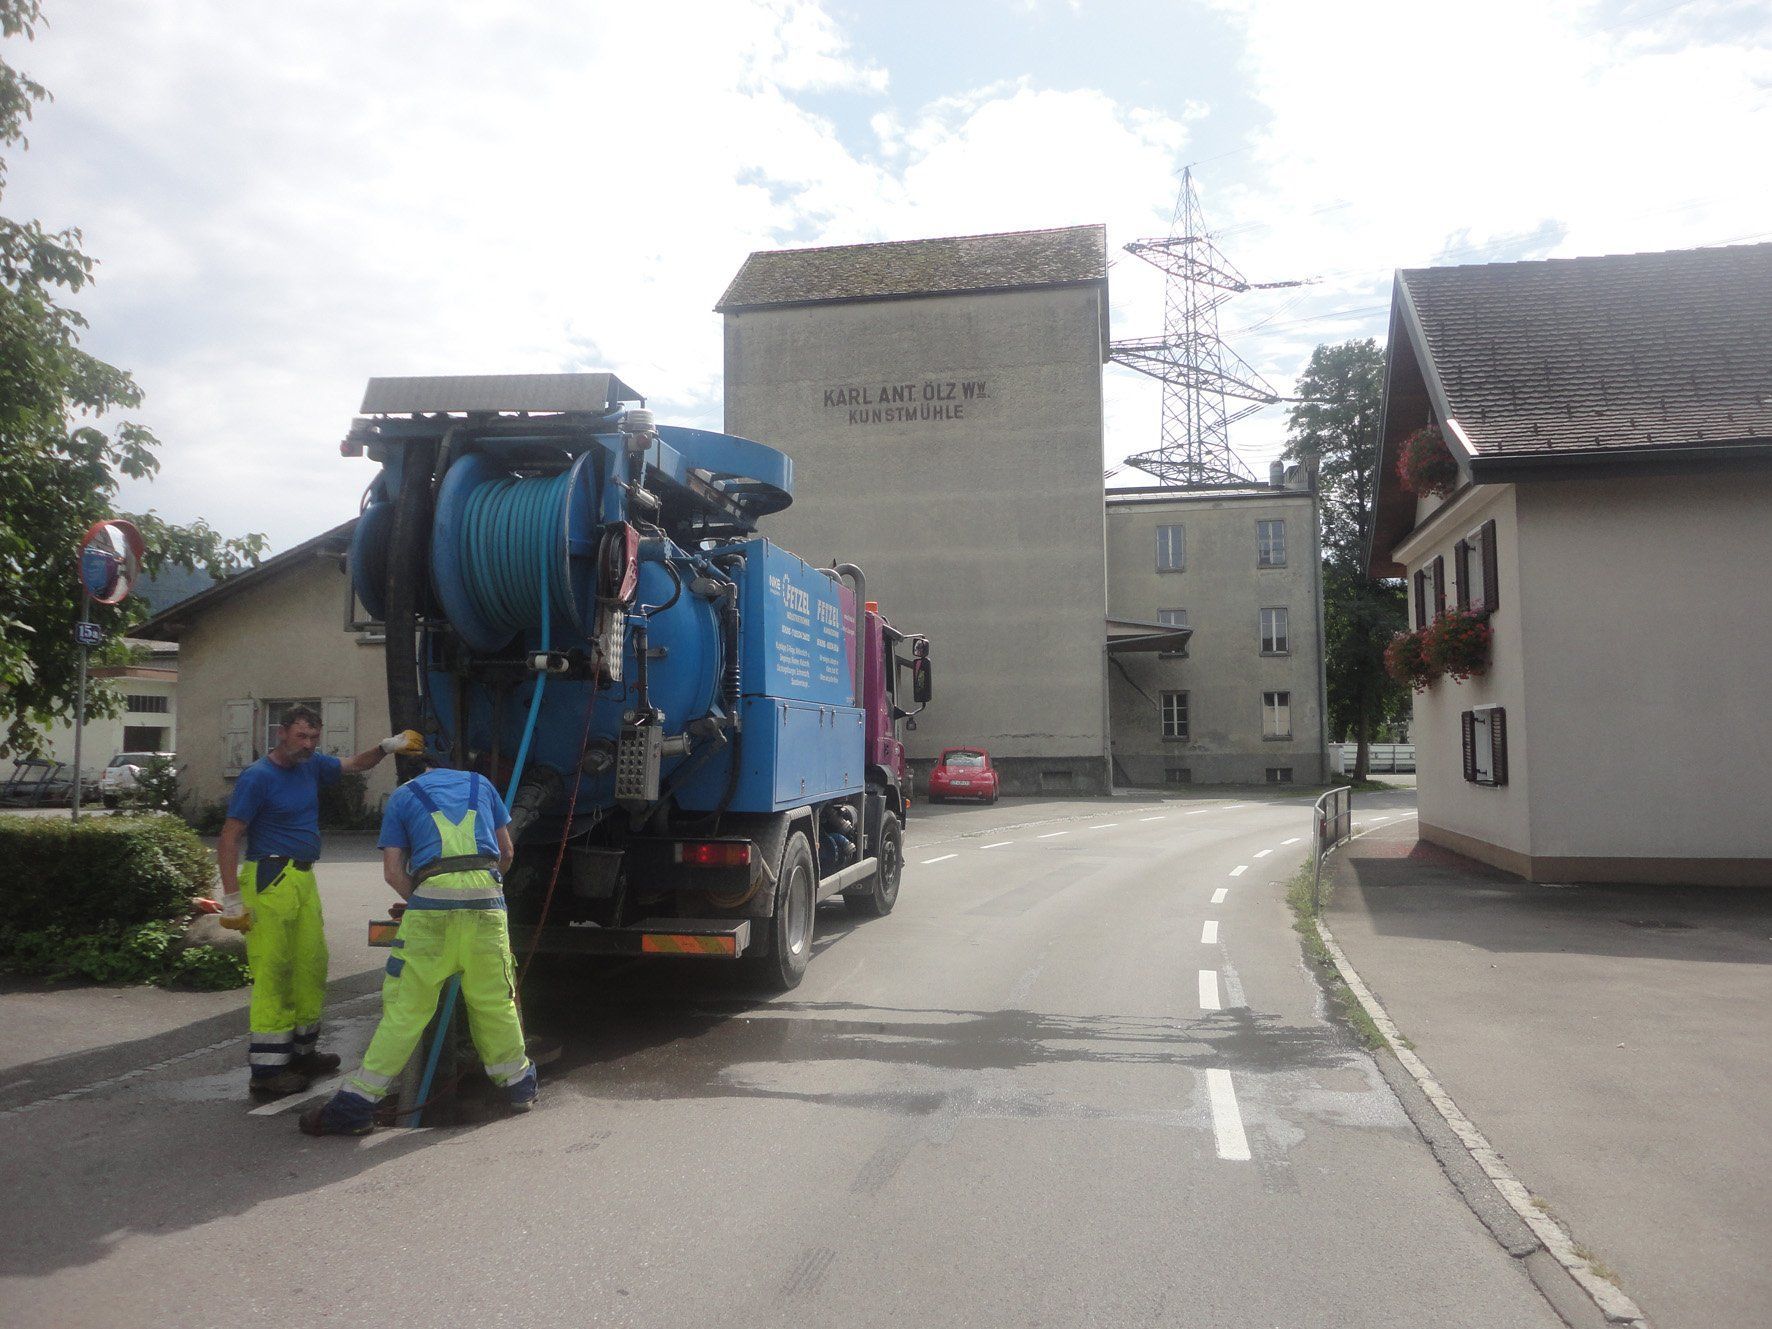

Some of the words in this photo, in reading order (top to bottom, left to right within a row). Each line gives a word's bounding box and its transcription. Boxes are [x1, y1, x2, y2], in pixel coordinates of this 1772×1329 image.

[824, 387, 873, 408] KARL
[923, 381, 956, 401] ÖLZ
[849, 403, 964, 424] KUNSTMÜHLE
[786, 584, 810, 616] FETZEL
[817, 600, 839, 629] FETZEL
